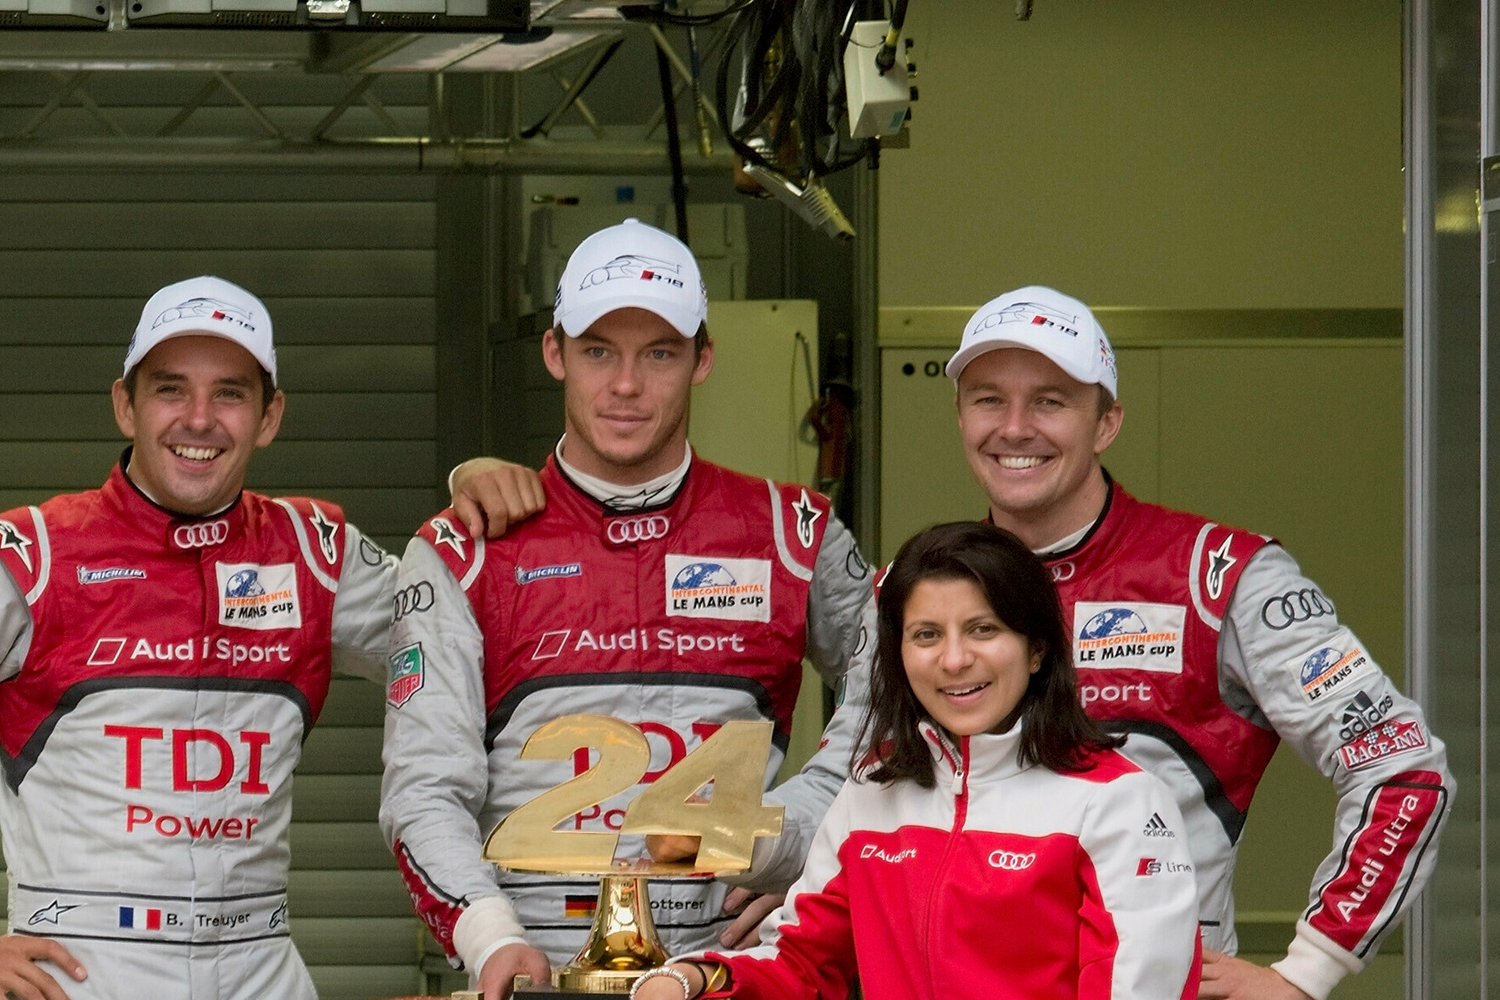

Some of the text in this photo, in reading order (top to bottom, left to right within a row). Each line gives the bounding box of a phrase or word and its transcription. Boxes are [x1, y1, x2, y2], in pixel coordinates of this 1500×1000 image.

[91, 569, 142, 580] MICHELIN
[528, 565, 578, 580] MICHELIN
[671, 585, 765, 598] INTERCONTINENTAL
[225, 602, 293, 619] LE MANS cup
[673, 595, 764, 610] LE MANS cup
[574, 629, 745, 655] Audi Sport
[1078, 632, 1178, 649] INTERCONTINENTAL
[130, 636, 290, 666] Audi Sport
[1080, 644, 1175, 662] LE MANS cup
[1308, 687, 1322, 701] LE
[1323, 665, 1352, 692] MANS
[1081, 681, 1151, 708] port
[1339, 694, 1394, 741] adidas
[1343, 724, 1425, 767] RACE-INN
[103, 724, 271, 795] TDI
[481, 714, 785, 869] 24
[126, 805, 259, 840] Power
[1143, 829, 1175, 838] adidas
[1166, 861, 1193, 873] line
[1337, 794, 1419, 922] Audi ultra
[650, 899, 704, 910] otterer
[167, 913, 183, 927] B.
